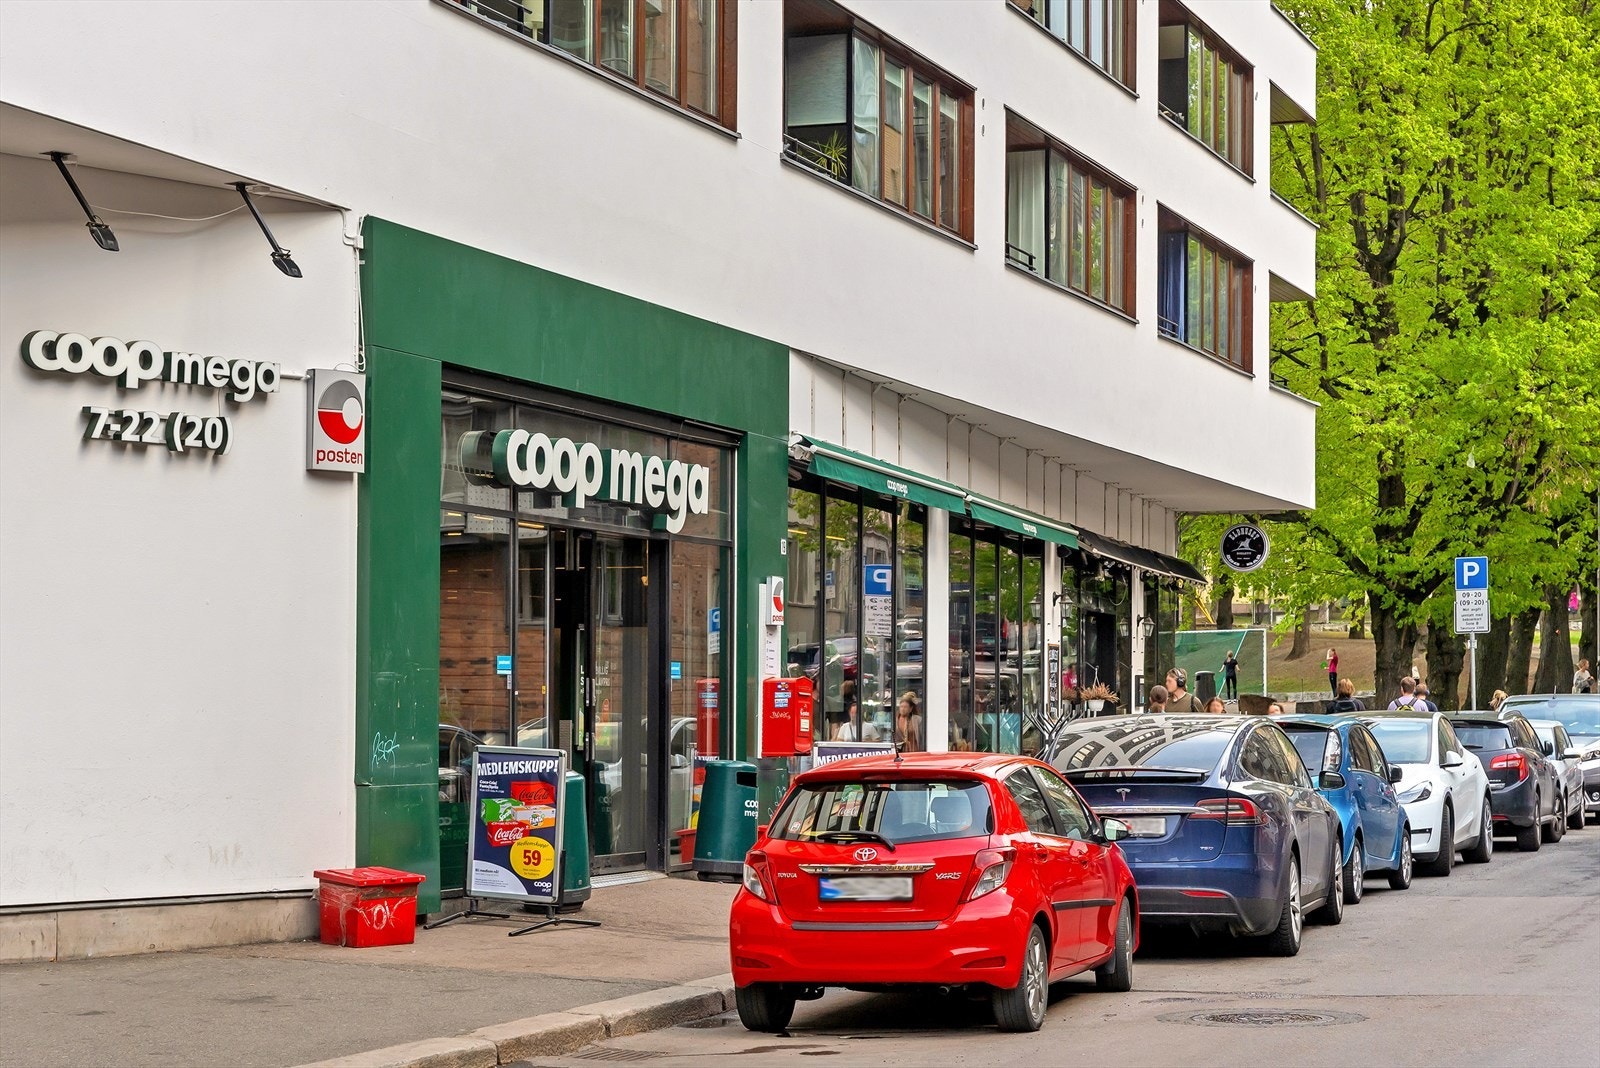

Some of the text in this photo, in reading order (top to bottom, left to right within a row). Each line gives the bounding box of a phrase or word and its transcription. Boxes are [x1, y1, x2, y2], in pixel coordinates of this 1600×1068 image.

[24, 330, 281, 403] coop mega
[83, 406, 234, 456] 7-22 (20)
[316, 448, 363, 464] posten
[505, 428, 710, 534] coop mega
[1464, 562, 1480, 585] P
[477, 760, 558, 776] MEDLEMSKUPP!
[519, 787, 549, 801] Coca-Cola
[494, 826, 525, 842] Coca-Cola
[522, 849, 542, 867] 59
[935, 871, 962, 880] YARIS
[533, 881, 552, 889] coop
